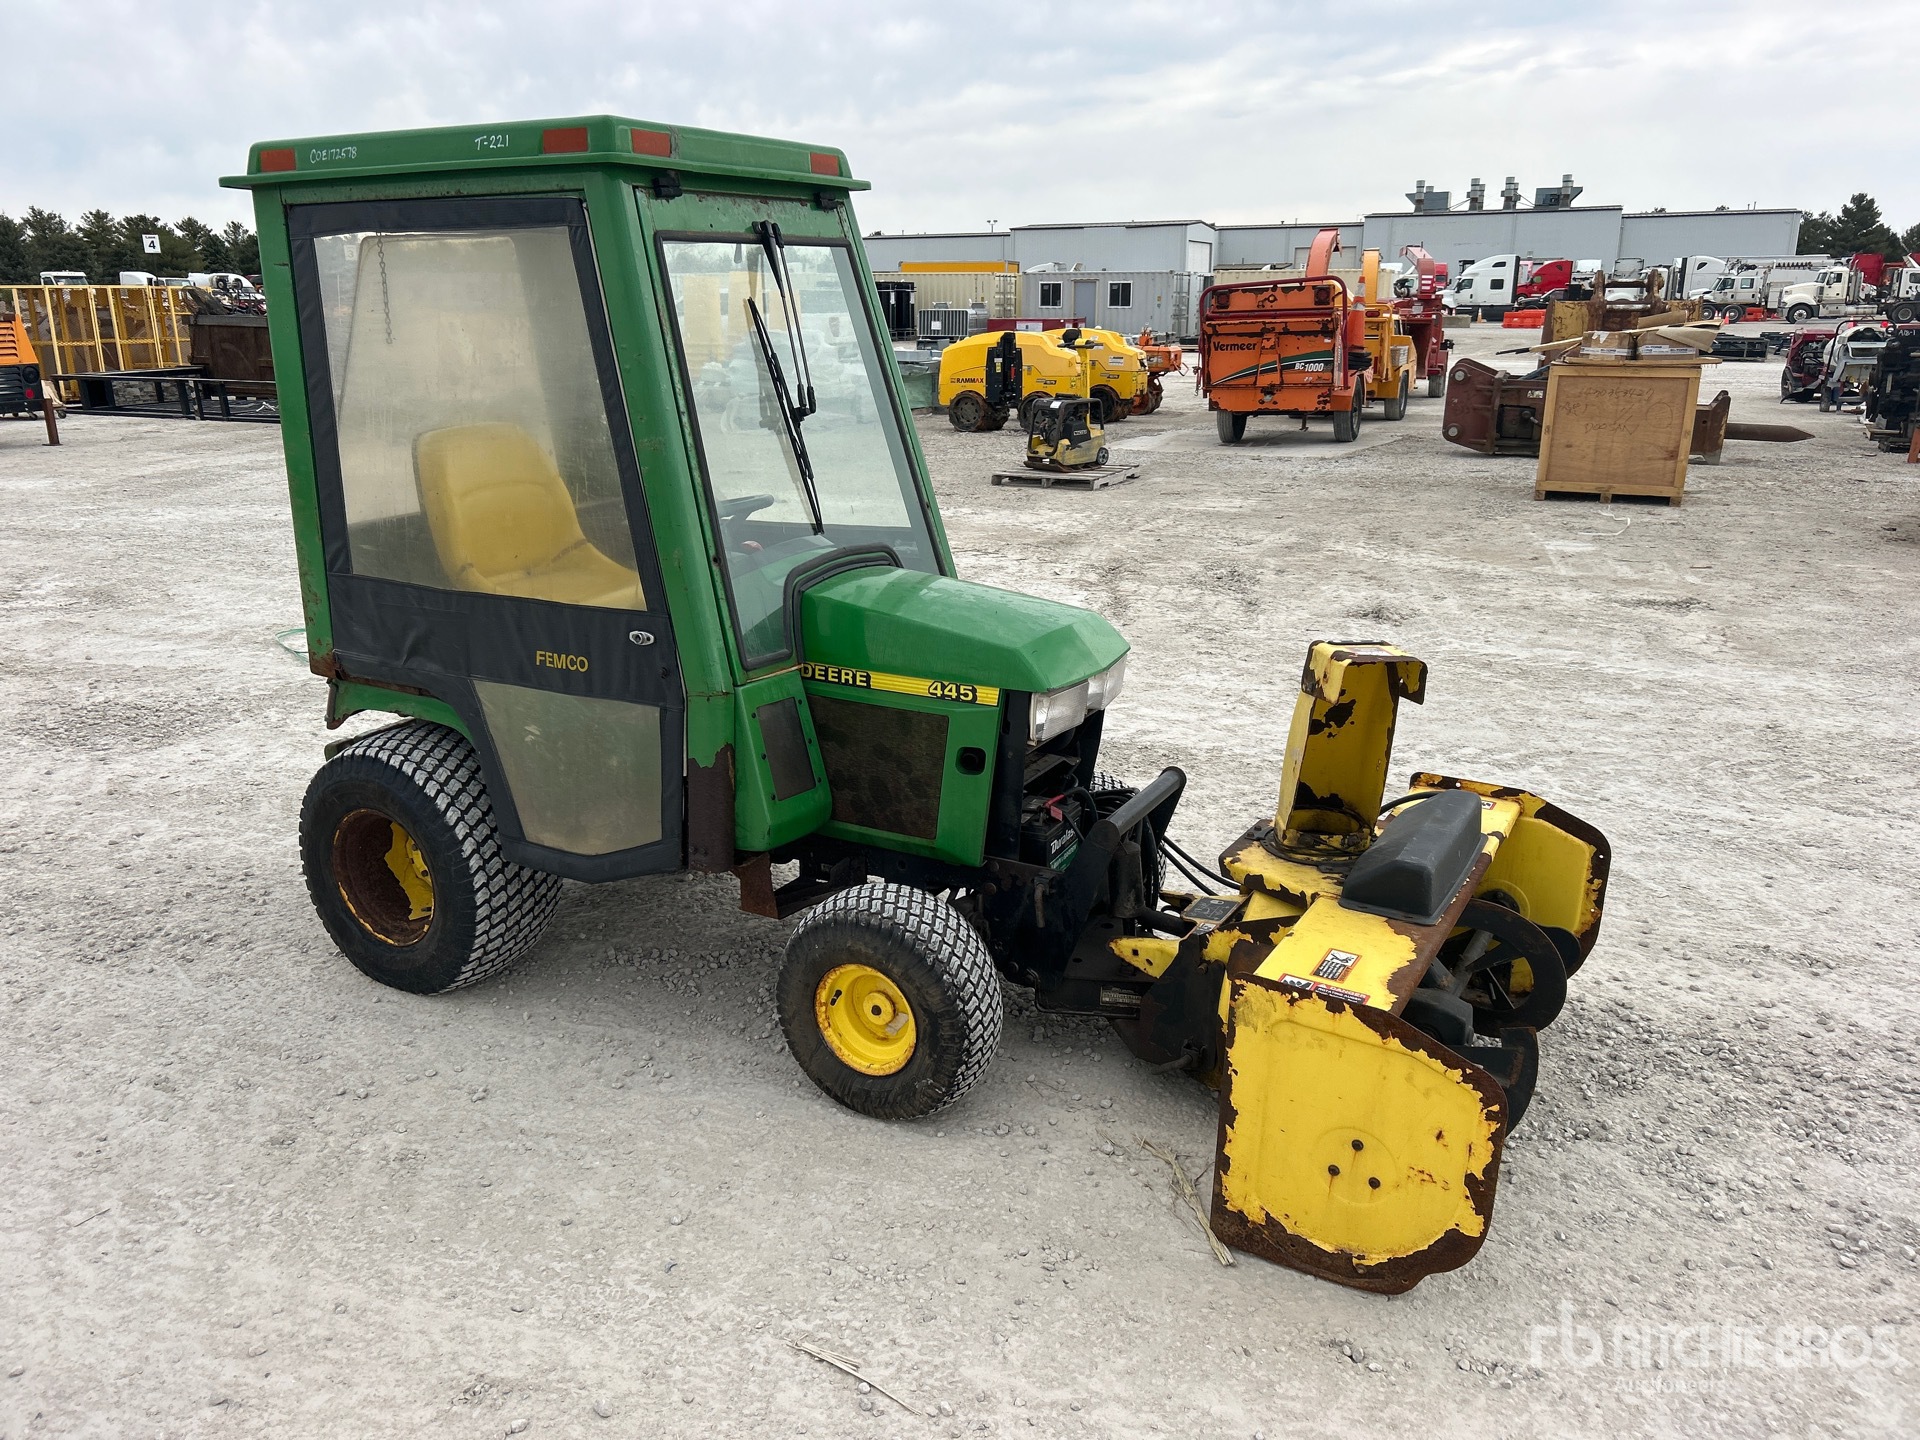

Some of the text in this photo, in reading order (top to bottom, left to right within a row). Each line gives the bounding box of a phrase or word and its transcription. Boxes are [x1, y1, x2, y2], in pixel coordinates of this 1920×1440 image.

[475, 134, 509, 150] T-221
[148, 240, 156, 249] 4
[1213, 341, 1257, 352] Vermeer
[1584, 422, 1640, 436] DOOSAN
[536, 650, 589, 673] FEMCO
[801, 663, 976, 703] DEERE 445
[1329, 985, 1367, 998] DANGER
